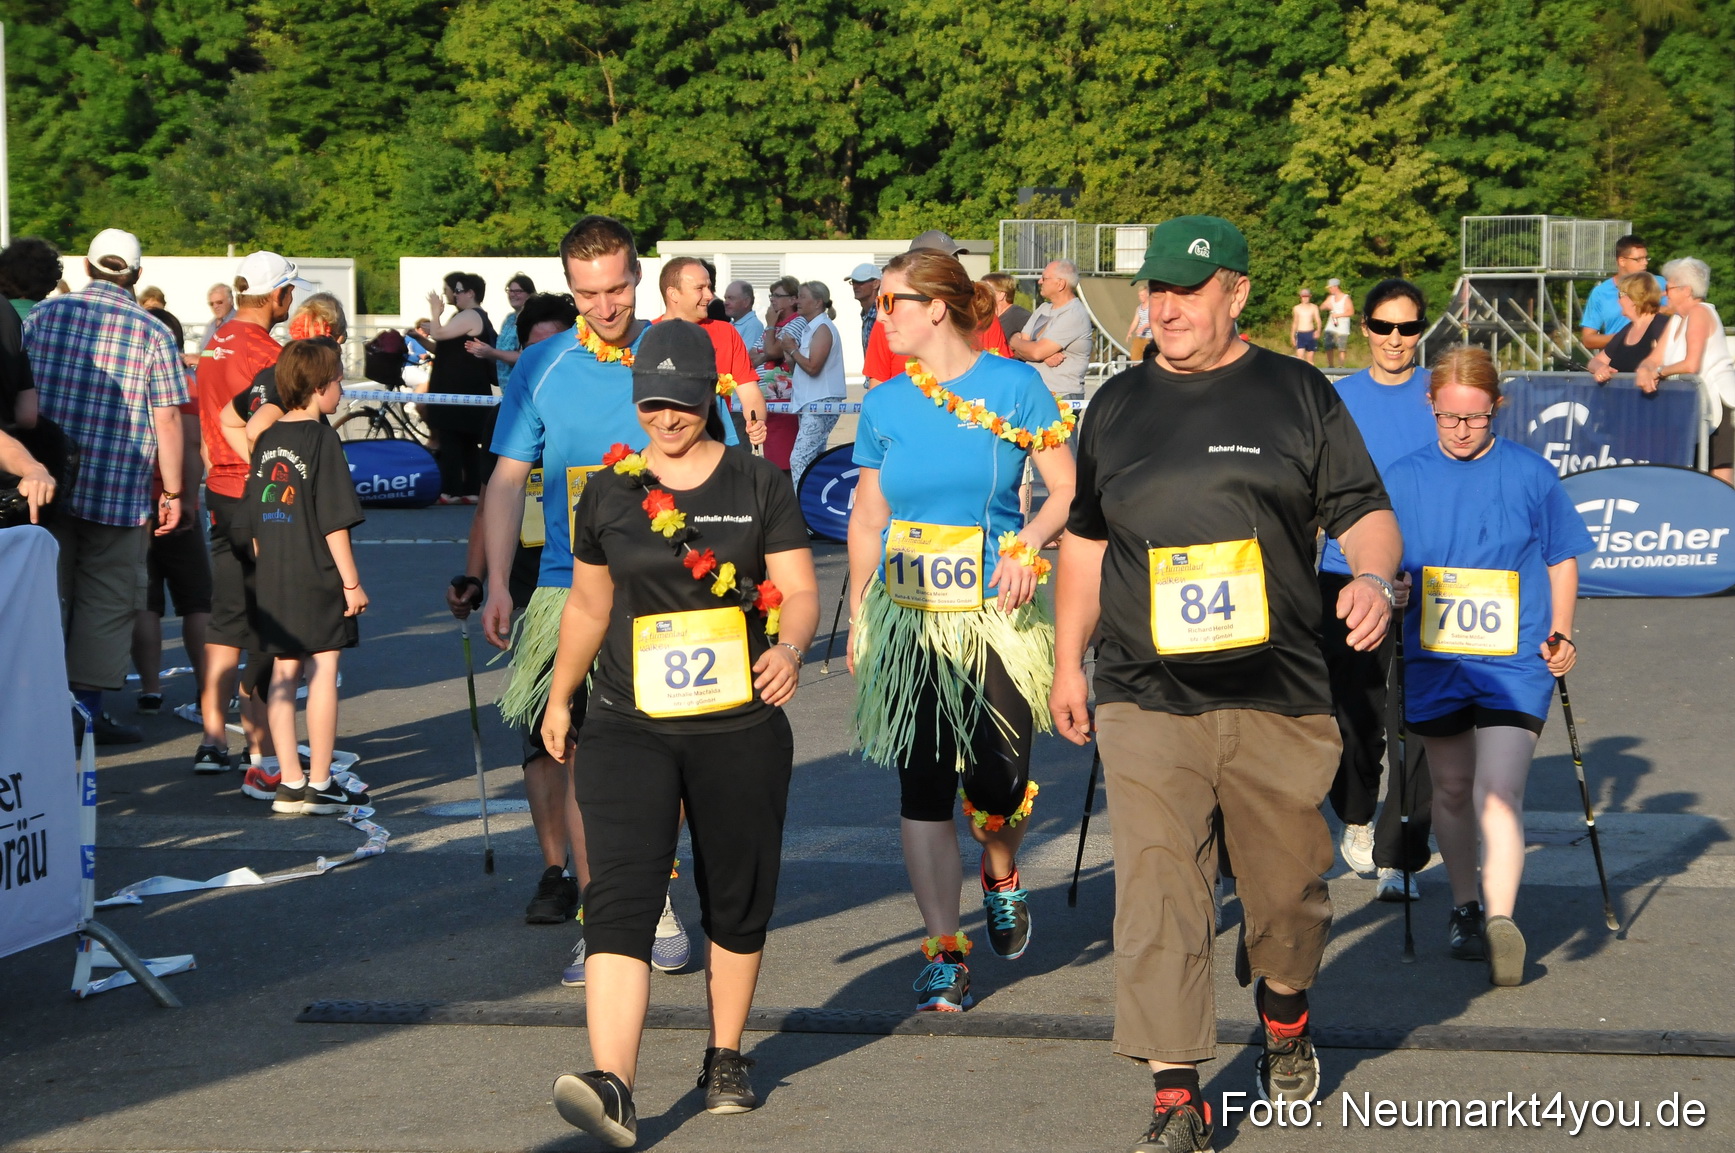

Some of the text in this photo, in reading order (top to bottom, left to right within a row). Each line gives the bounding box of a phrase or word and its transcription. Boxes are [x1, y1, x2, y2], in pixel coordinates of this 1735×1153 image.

[1208, 445, 1261, 454] Richard Herold
[1542, 442, 1650, 477] Fisch
[355, 472, 421, 495] cher
[694, 514, 722, 523] Nathalie
[889, 552, 977, 590] 1166
[1165, 562, 1204, 573] firmenlauf
[1590, 553, 1718, 570] AUTOMOBILE
[1180, 580, 1236, 625] 84
[1434, 597, 1502, 634] 706
[649, 629, 688, 640] firmenlauf
[1187, 623, 1234, 634] Richard Herold
[664, 647, 718, 690] 82
[667, 691, 693, 699] Nathalie
[0, 818, 47, 890] räu
